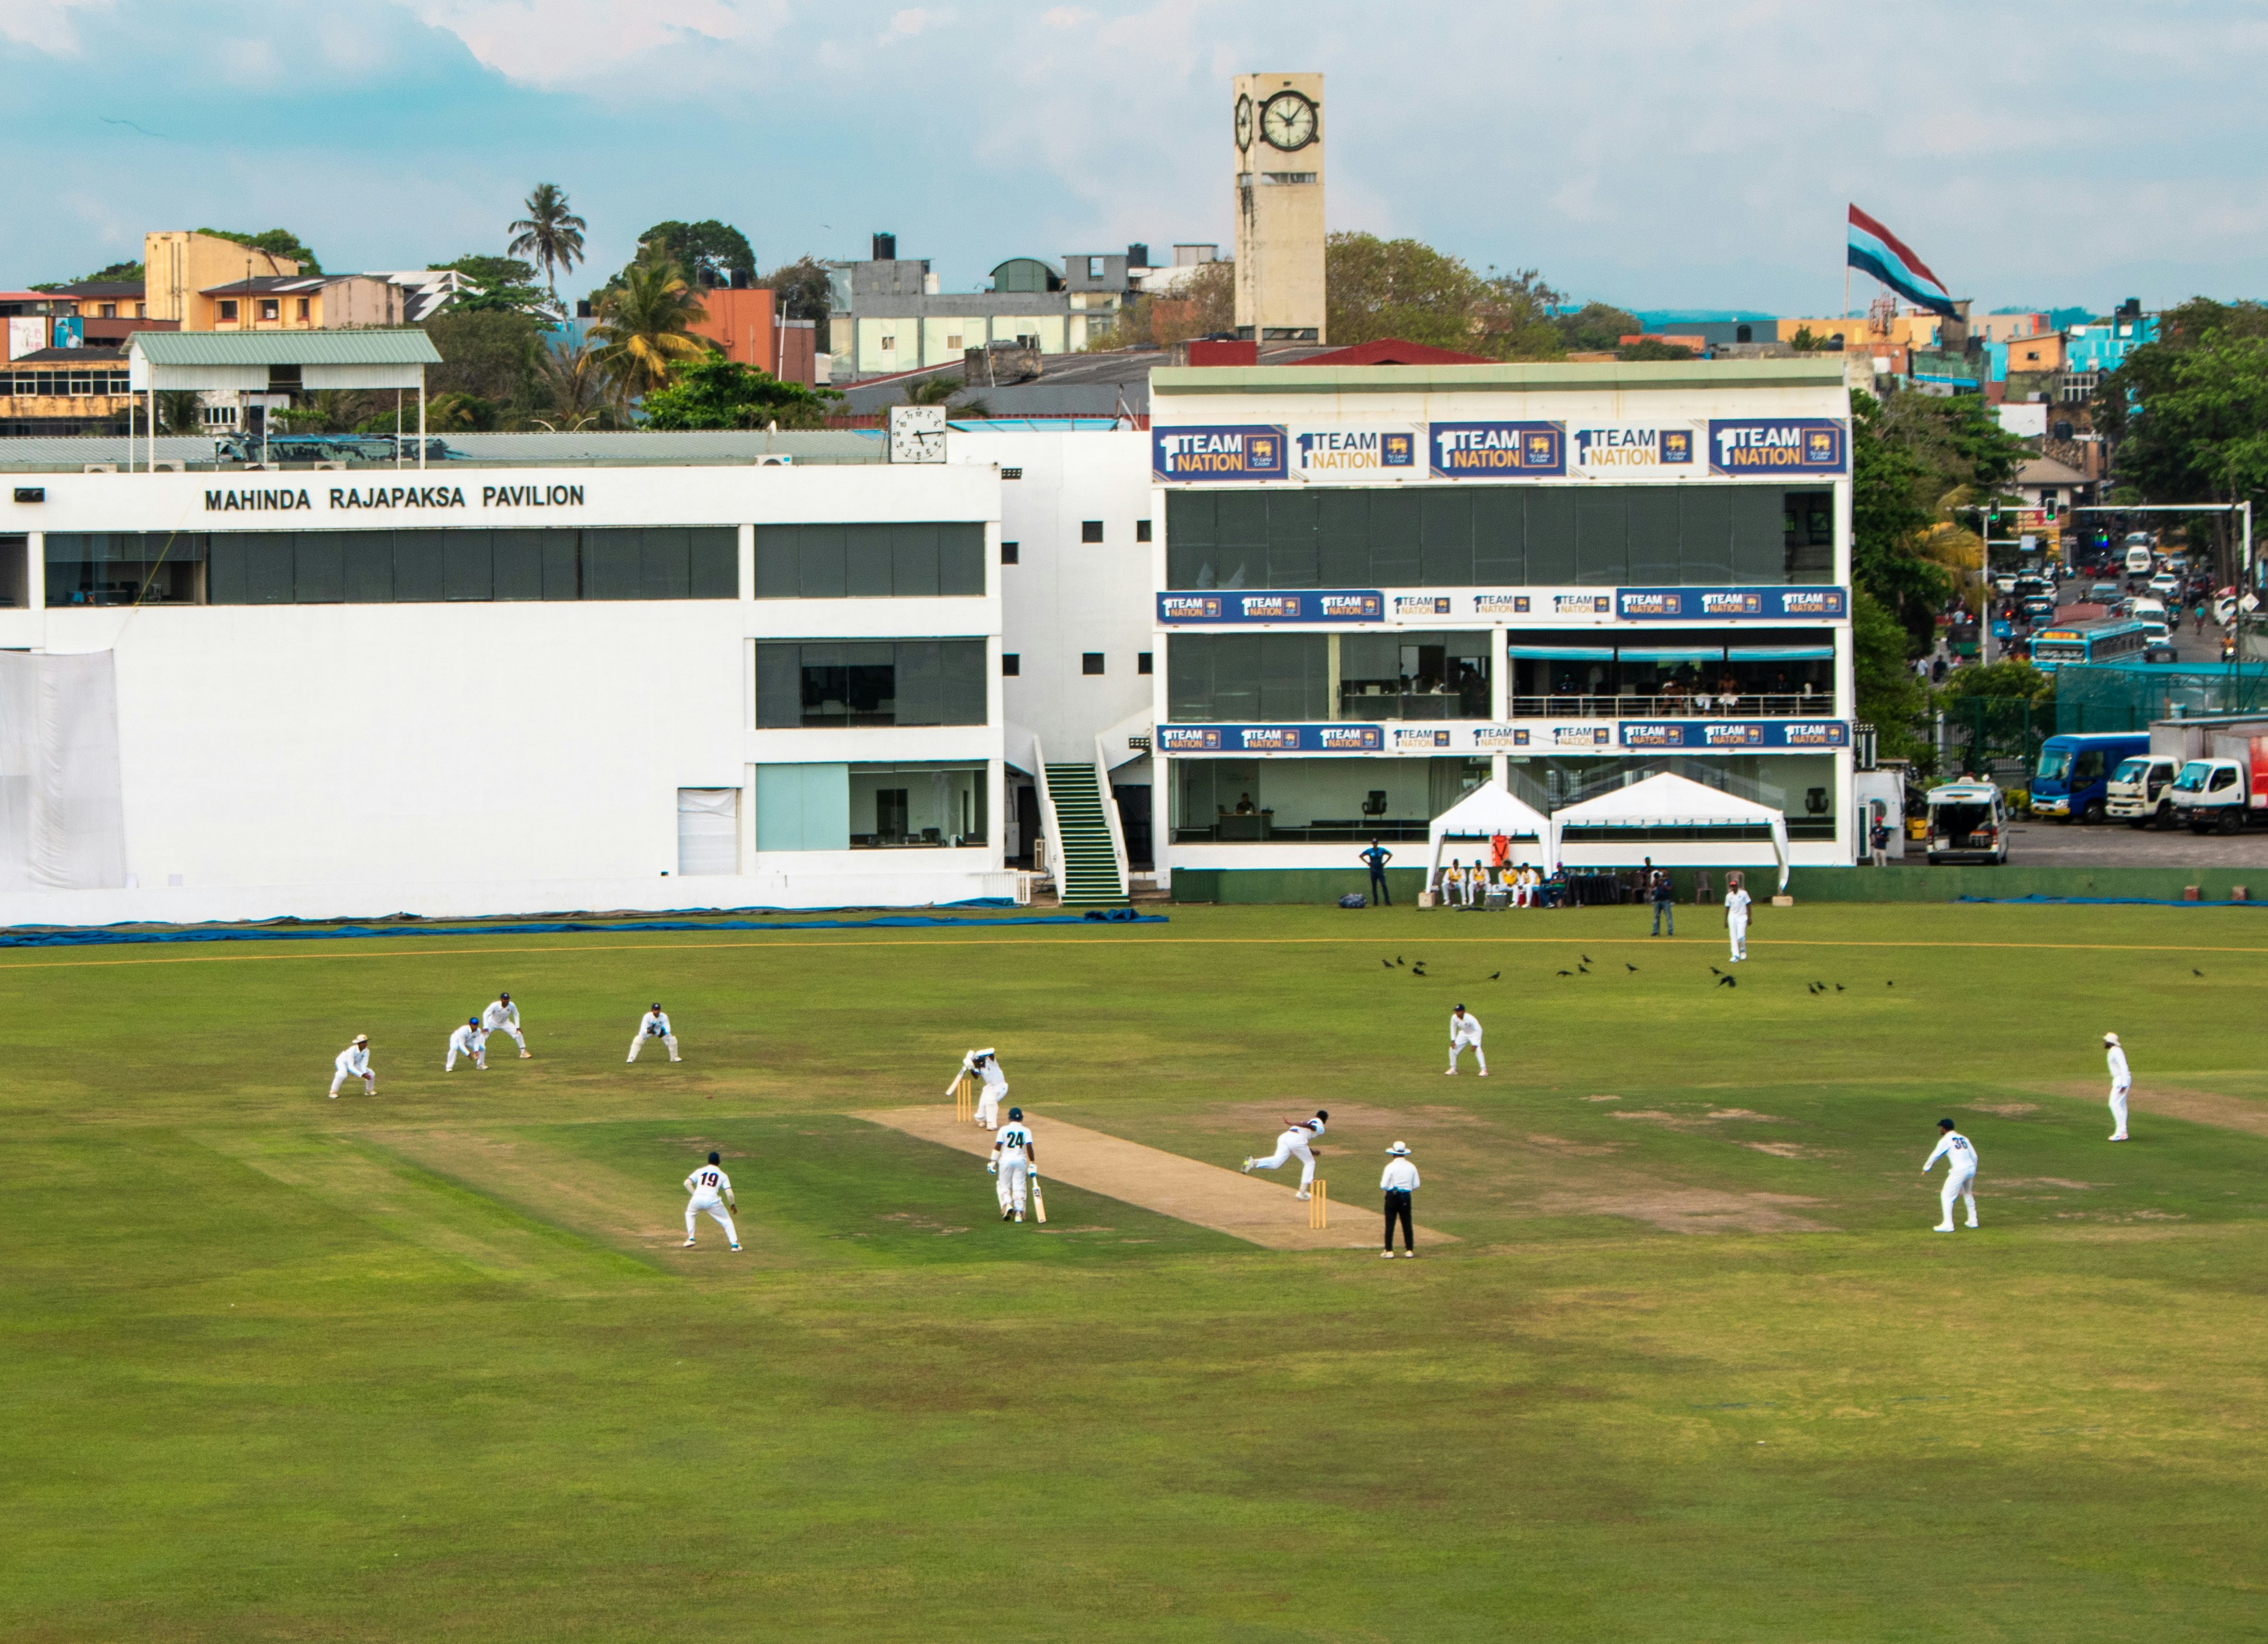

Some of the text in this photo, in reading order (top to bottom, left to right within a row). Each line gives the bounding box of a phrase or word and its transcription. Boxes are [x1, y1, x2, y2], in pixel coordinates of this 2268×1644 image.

[1315, 433, 1377, 449] TEAM
[1456, 431, 1520, 449] TEAM
[1593, 429, 1655, 446] TEAM
[1736, 428, 1800, 446] TEAM
[1179, 435, 1242, 453] TEAM
[1313, 452, 1377, 468] NATION
[1454, 450, 1519, 467] NATION
[1591, 449, 1656, 465] NATION
[1734, 448, 1800, 465] NATION
[1177, 453, 1242, 471] NATION
[205, 485, 584, 511] MAHINDA RAJAPAKSA PAVILION
[1172, 598, 1203, 608] TEAM
[1251, 598, 1282, 607] TEAM
[1330, 597, 1361, 606] TEAM
[1403, 597, 1433, 605] TEAM
[1482, 596, 1512, 604] TEAM
[1561, 596, 1592, 604] TEAM
[1630, 595, 1662, 605] TEAM
[1711, 594, 1743, 604] TEAM
[1791, 594, 1823, 604] TEAM
[1170, 608, 1203, 616] NATION
[1250, 607, 1282, 616] NATION
[1329, 606, 1361, 615] NATION
[1401, 605, 1433, 614] NATION
[1482, 605, 1513, 613] NATION
[1561, 605, 1593, 613] NATION
[1629, 605, 1662, 613] NATION
[1710, 604, 1743, 613] NATION
[1790, 604, 1823, 612] NATION
[1329, 729, 1360, 739] TEAM
[1402, 730, 1432, 738] TEAM
[1482, 728, 1512, 737] TEAM
[1561, 728, 1592, 736] TEAM
[1633, 726, 1665, 736] TEAM
[1713, 726, 1745, 735] TEAM
[1793, 725, 1825, 735] TEAM
[1172, 730, 1202, 740] TEAM
[1251, 730, 1281, 740] TEAM
[1712, 735, 1745, 744] NATION
[1169, 740, 1202, 748] NATION
[1250, 740, 1282, 748] NATION
[1328, 739, 1360, 747] NATION
[1401, 738, 1433, 747] NATION
[1481, 737, 1512, 746] NATION
[1561, 737, 1592, 745] NATION
[1632, 736, 1665, 744] NATION
[1007, 1131, 1024, 1148] 24
[701, 1172, 719, 1187] 19
